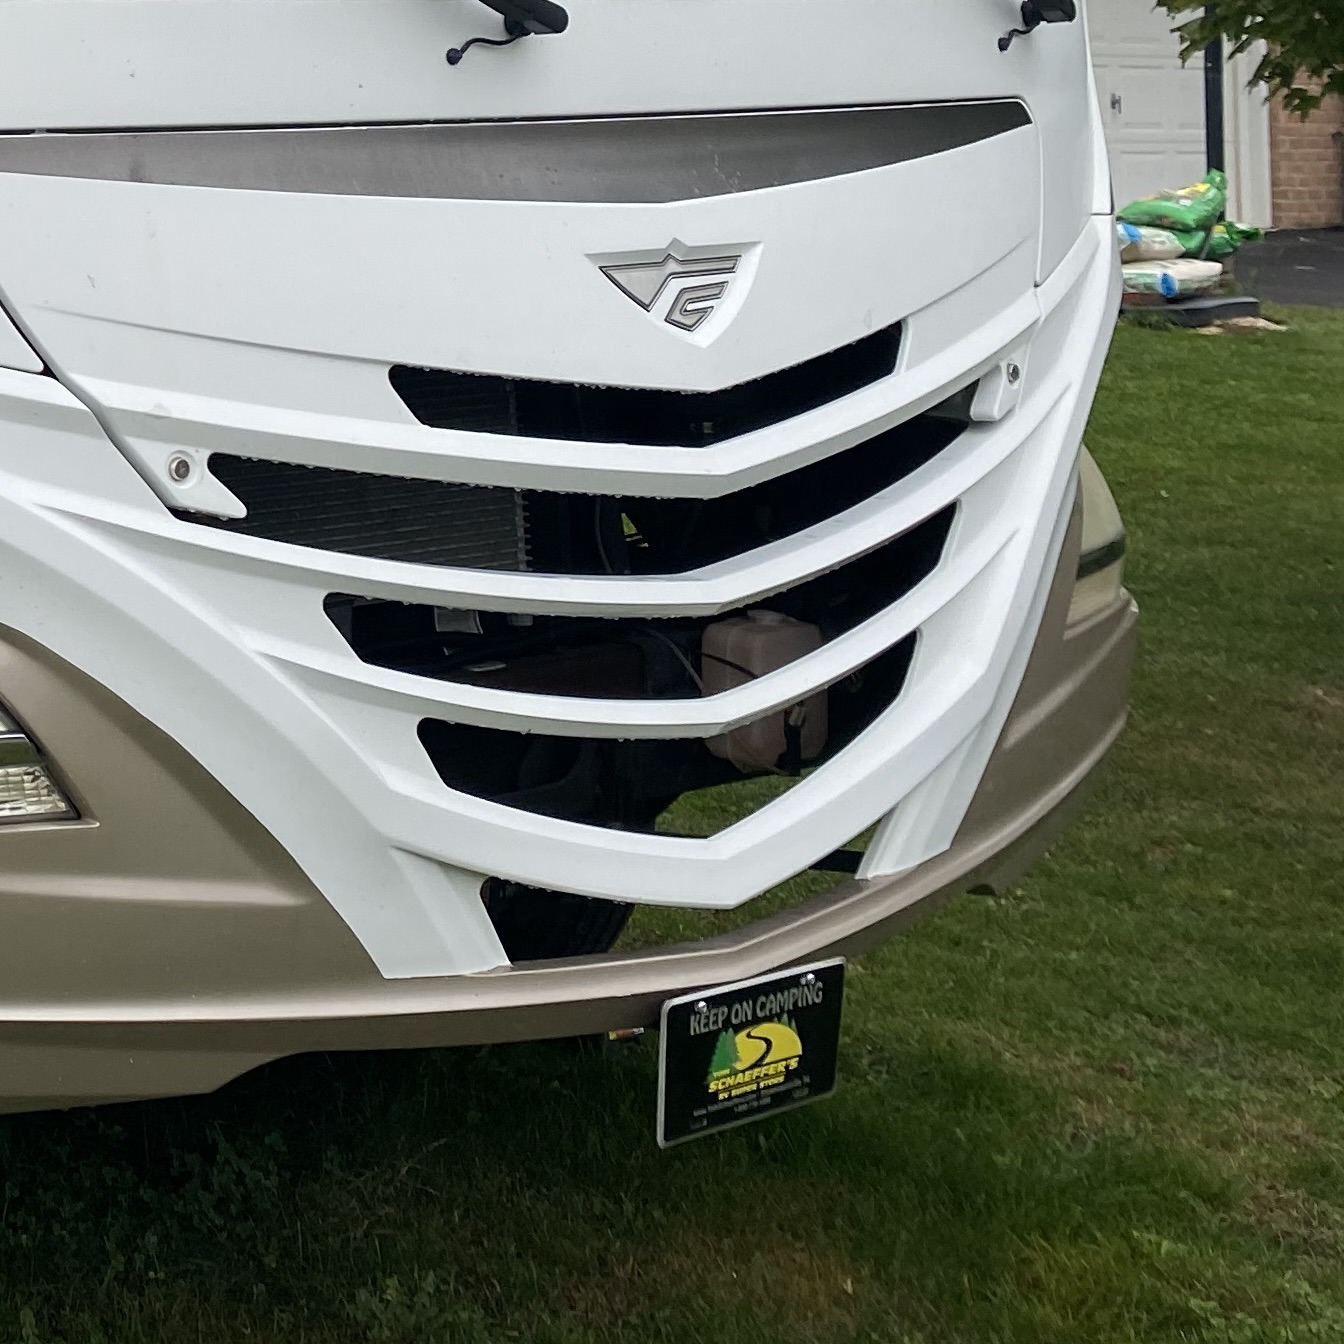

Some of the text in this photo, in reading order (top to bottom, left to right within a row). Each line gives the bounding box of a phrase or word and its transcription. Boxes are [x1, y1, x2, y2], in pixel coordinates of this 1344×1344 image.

[690, 981, 823, 1036] KEEP ON CAMPING
[708, 1057, 800, 1093] SCHAEFFER'S
